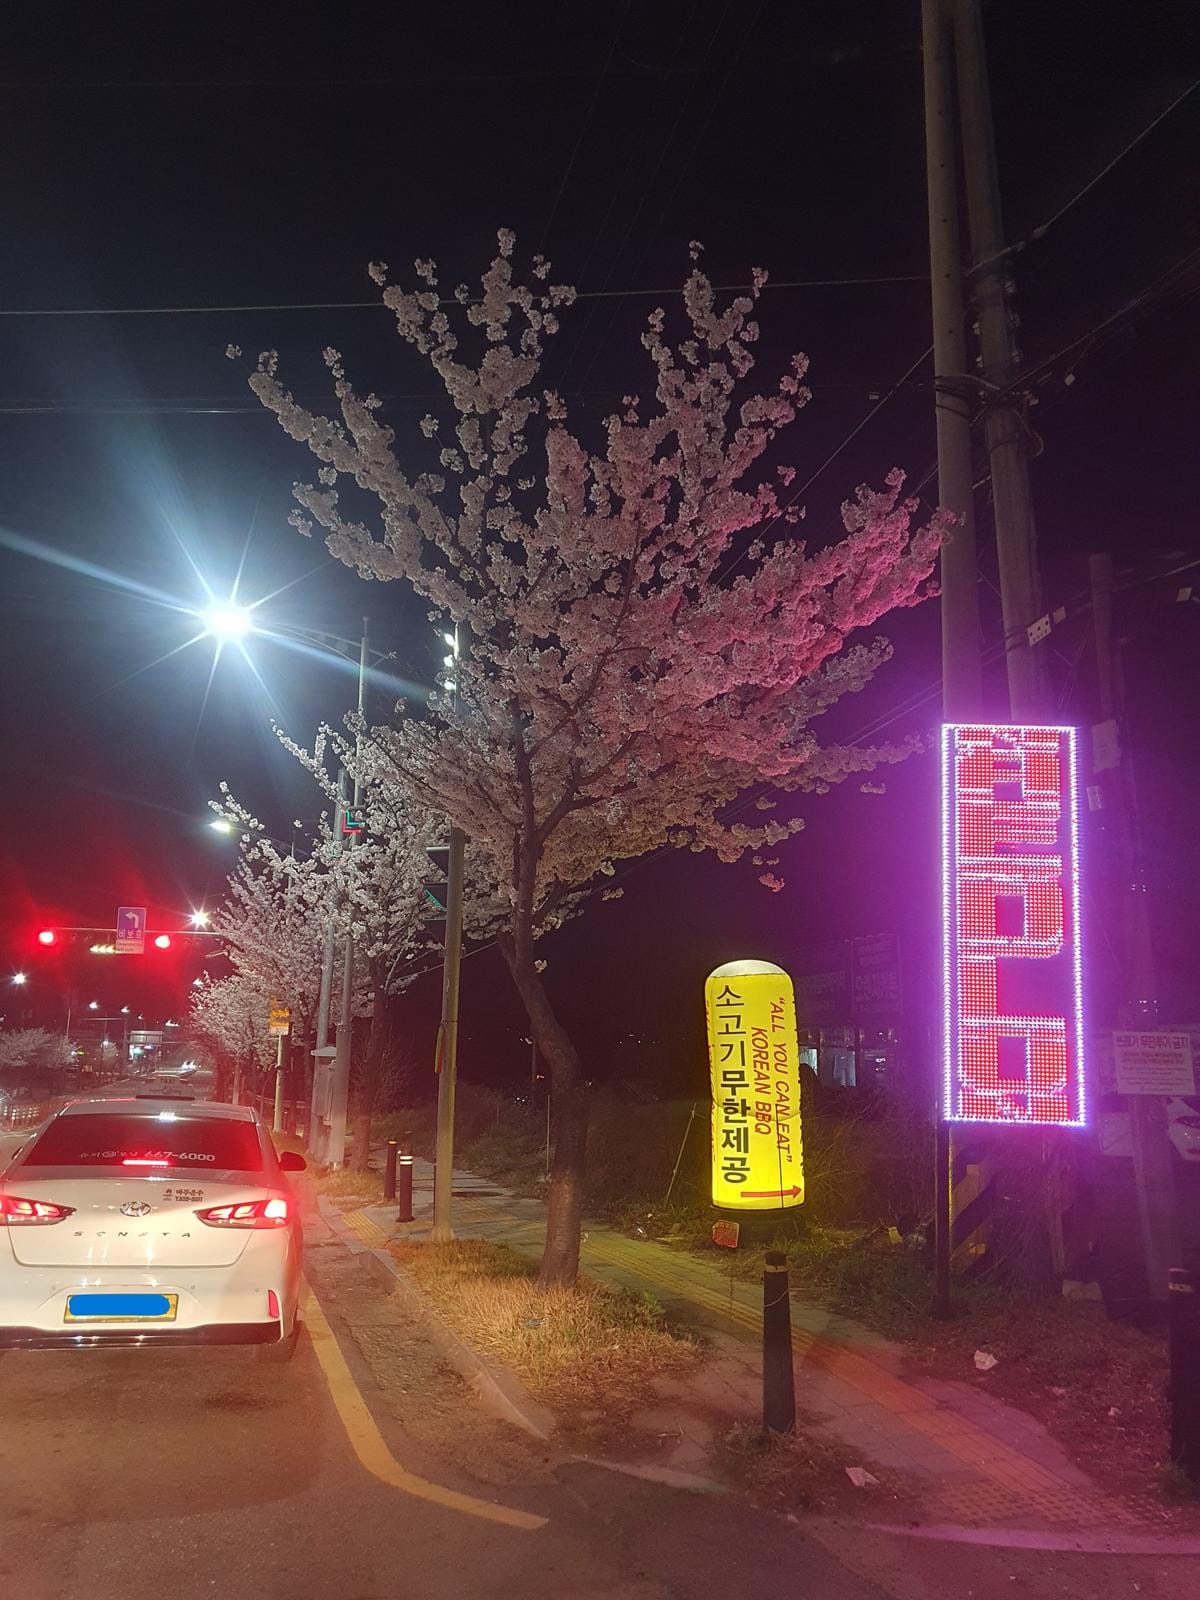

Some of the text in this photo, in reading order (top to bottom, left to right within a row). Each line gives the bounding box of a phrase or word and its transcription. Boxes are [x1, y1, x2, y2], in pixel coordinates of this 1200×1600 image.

[118, 928, 142, 939] 비보호
[773, 1042, 788, 1075] YOU
[751, 1026, 772, 1135] KOREAN BBQ
[775, 1080, 791, 1117] CAN
[144, 1150, 216, 1162] 667-6000
